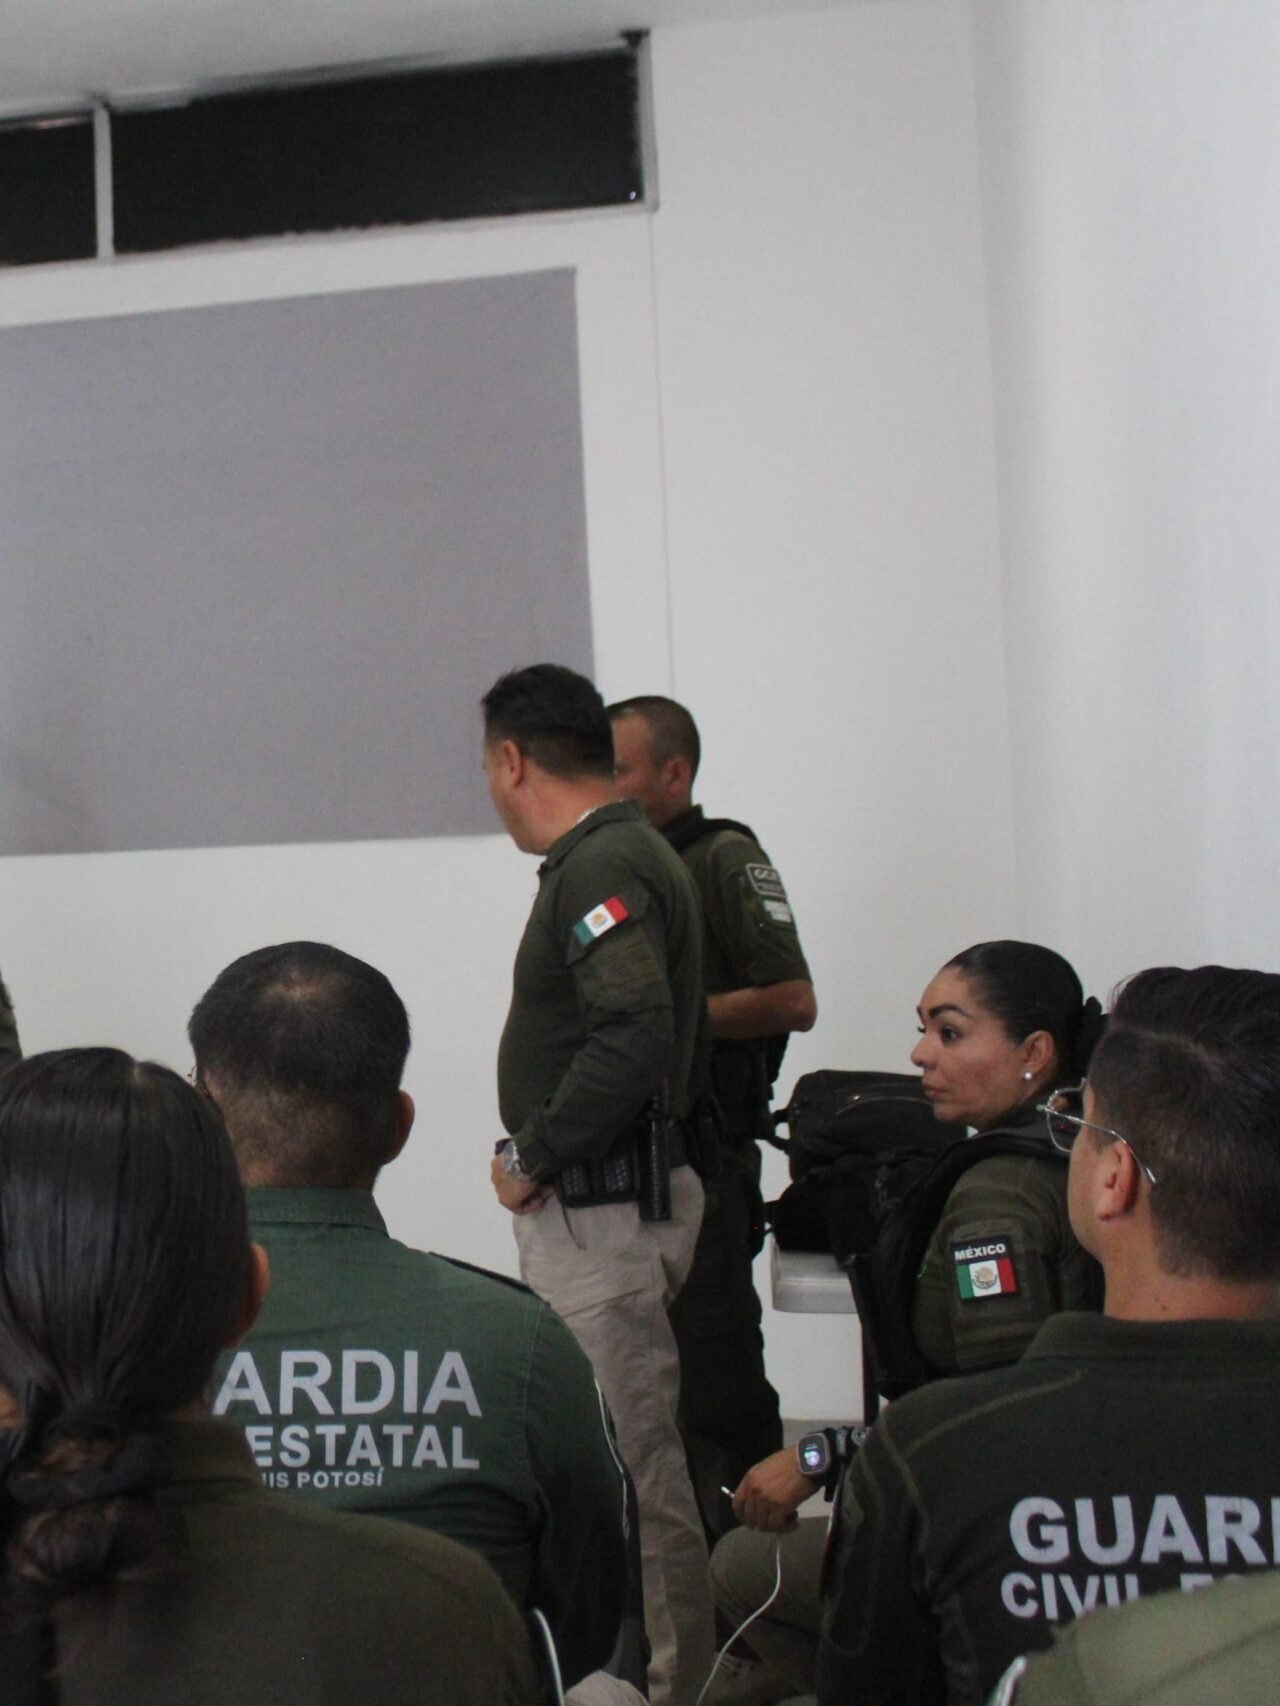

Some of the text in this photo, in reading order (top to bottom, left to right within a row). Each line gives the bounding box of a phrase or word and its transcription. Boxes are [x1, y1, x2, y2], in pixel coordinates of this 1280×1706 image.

[954, 1243, 1006, 1261] MÉXICO
[245, 1424, 480, 1469] ESTATAL
[297, 1468, 385, 1489] POTOSÍ
[1009, 1494, 1280, 1566] GUAR
